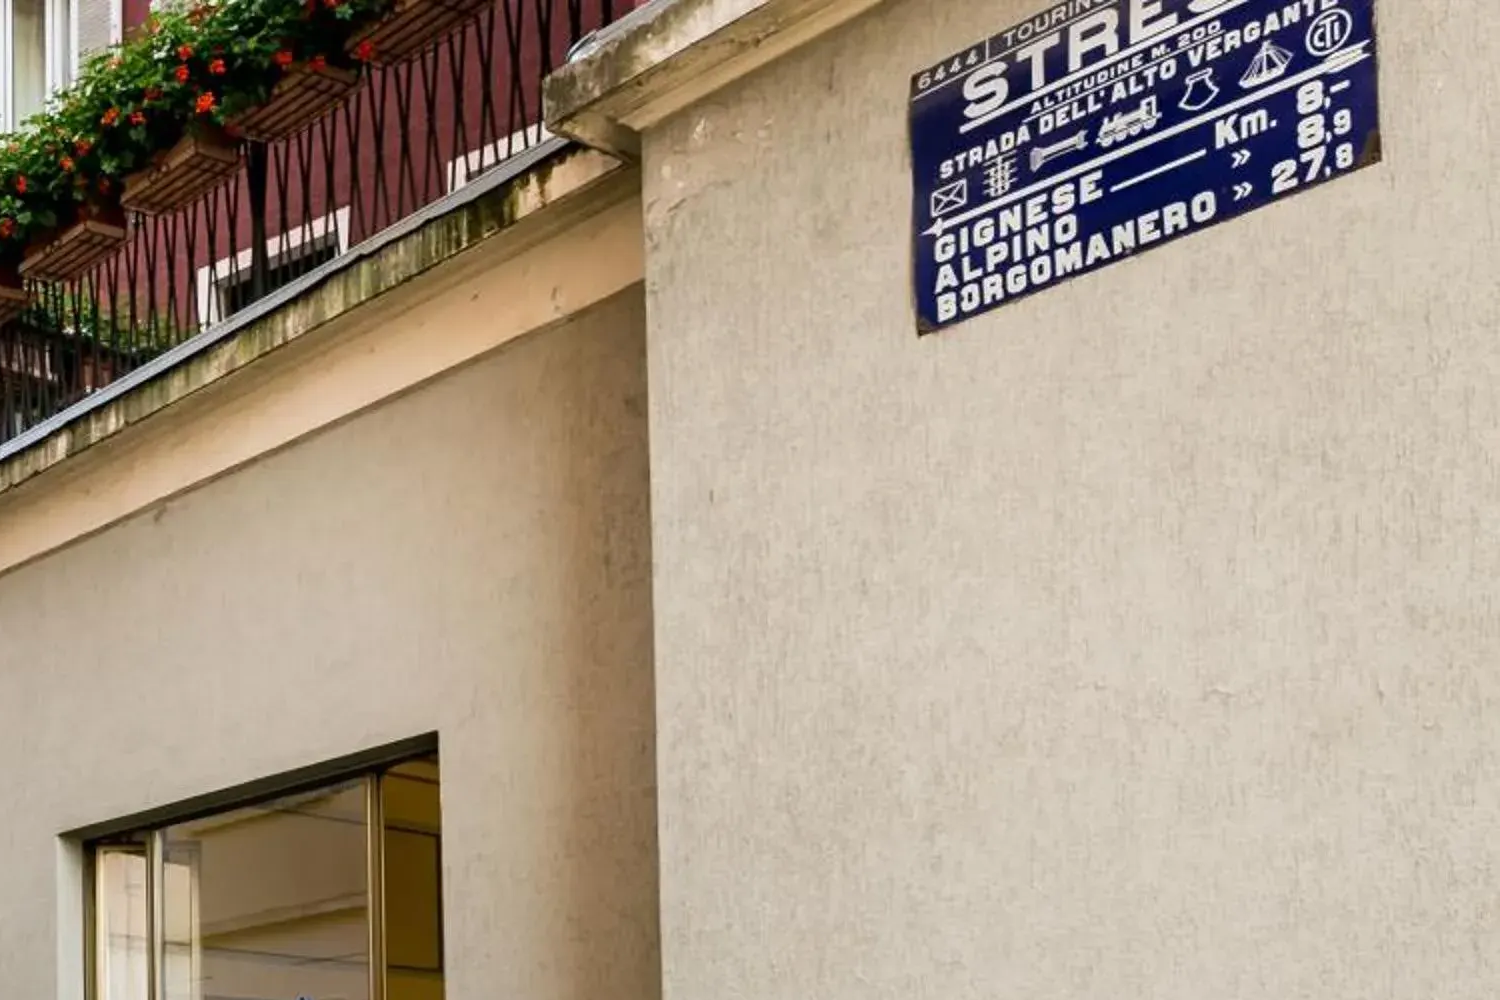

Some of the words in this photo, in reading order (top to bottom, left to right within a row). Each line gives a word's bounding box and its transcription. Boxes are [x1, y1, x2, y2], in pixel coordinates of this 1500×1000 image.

[962, 0, 1227, 119] STRE
[1004, 0, 1107, 48] TOURIN
[1030, 53, 1144, 115] ALTITUDINE
[1178, 20, 1221, 48] 200
[933, 169, 1103, 264] GIGNESE
[1214, 108, 1278, 150] Km.
[934, 213, 1078, 295] ALPINO
[1297, 108, 1353, 150] 8,9
[939, 123, 1031, 180] STRADA
[936, 190, 1217, 324] BORGOMANERO
[1270, 141, 1354, 195] 27,8
